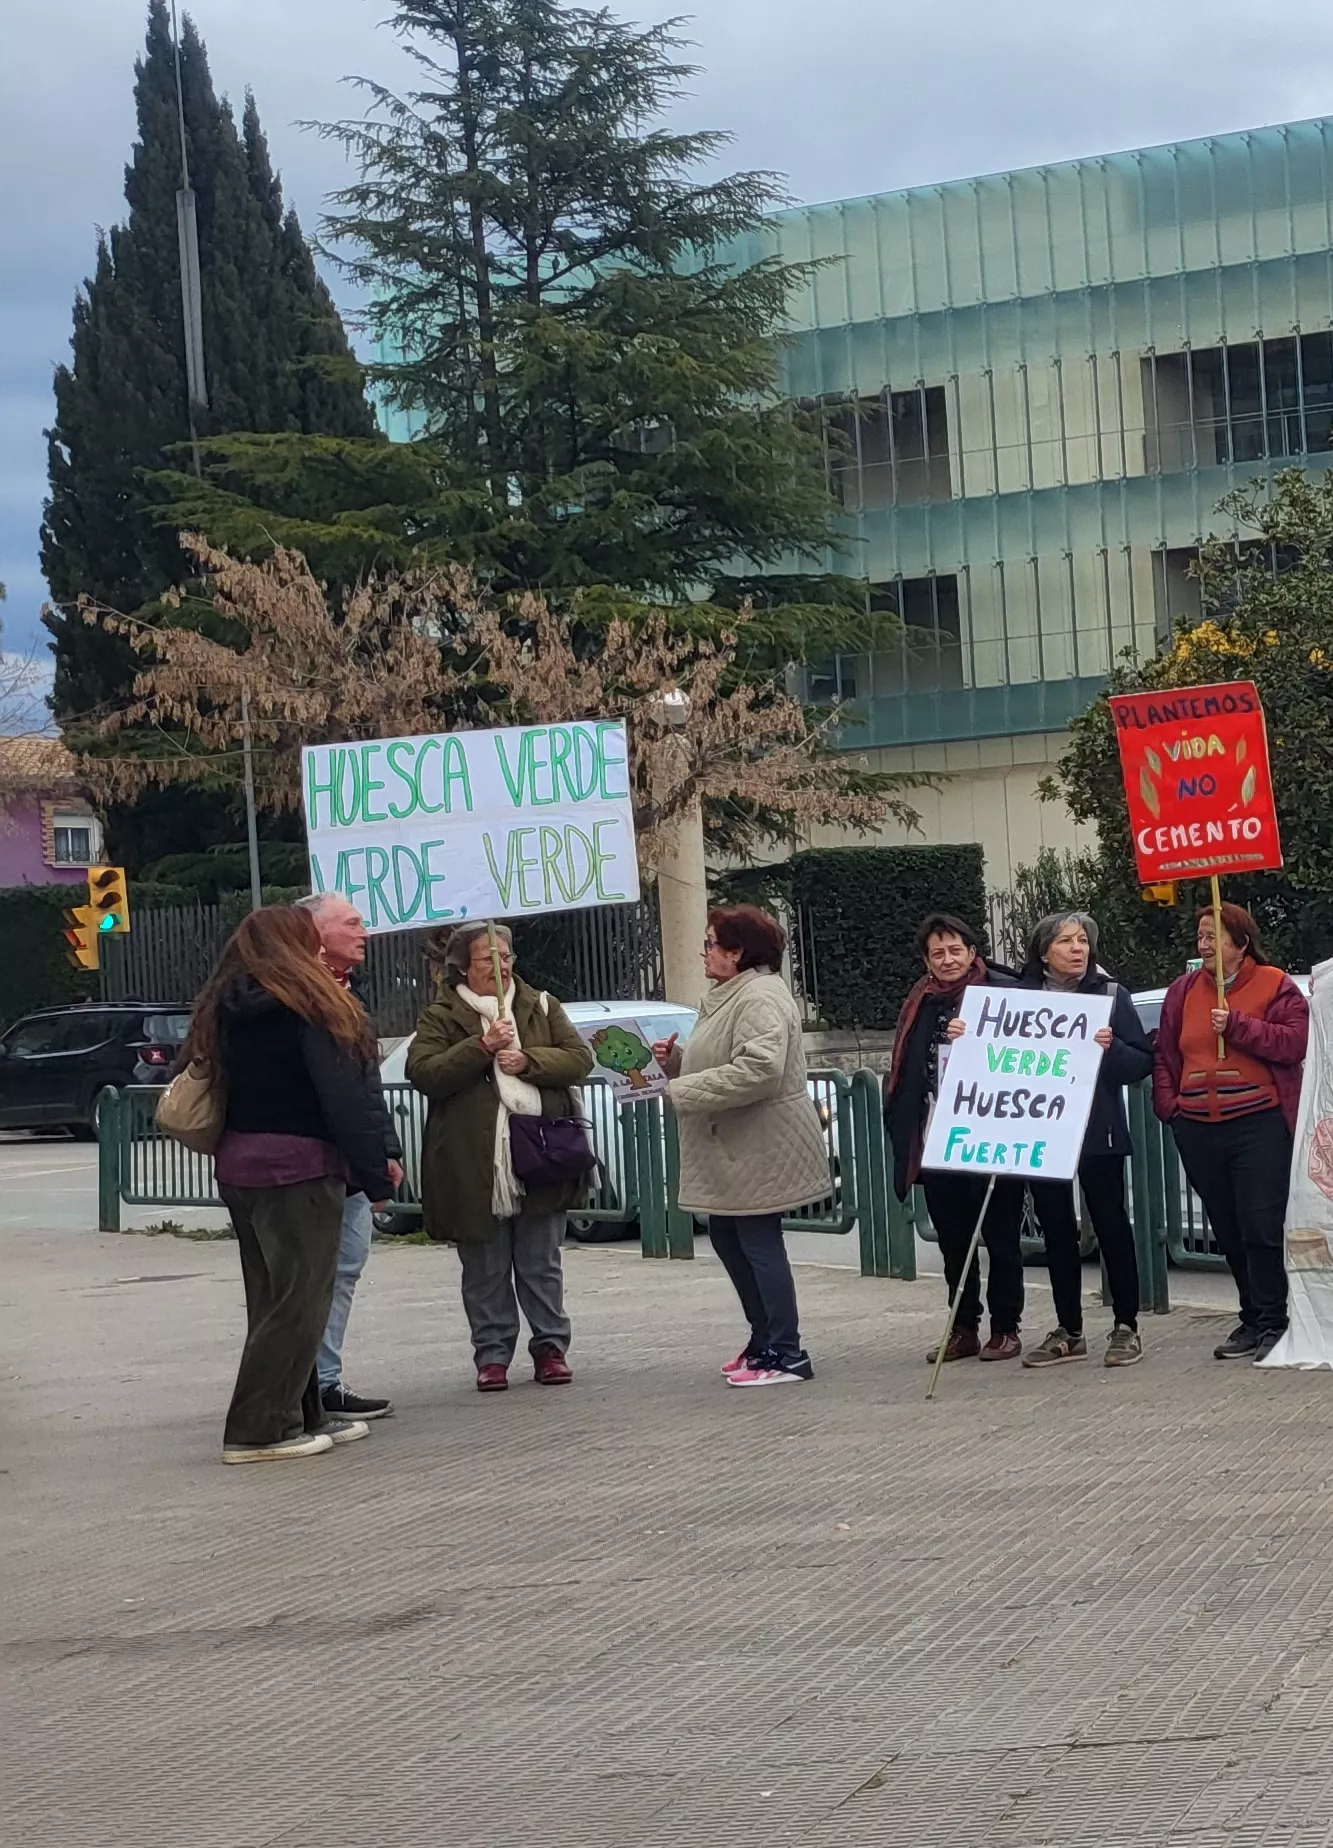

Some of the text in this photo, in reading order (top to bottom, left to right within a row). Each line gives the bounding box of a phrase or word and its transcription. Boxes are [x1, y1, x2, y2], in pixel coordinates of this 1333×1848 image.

[1116, 693, 1253, 730] PLANTEMOS
[307, 723, 628, 830] HUESCA VERDE
[1177, 774, 1216, 800] NO
[1137, 817, 1262, 855] CEMENTO
[484, 819, 625, 909] VERDE
[976, 995, 1088, 1040] HUESCA
[987, 1043, 1076, 1084] VERDE,
[953, 1080, 1066, 1120] HUESCA
[944, 1127, 1046, 1168] FUERTE
